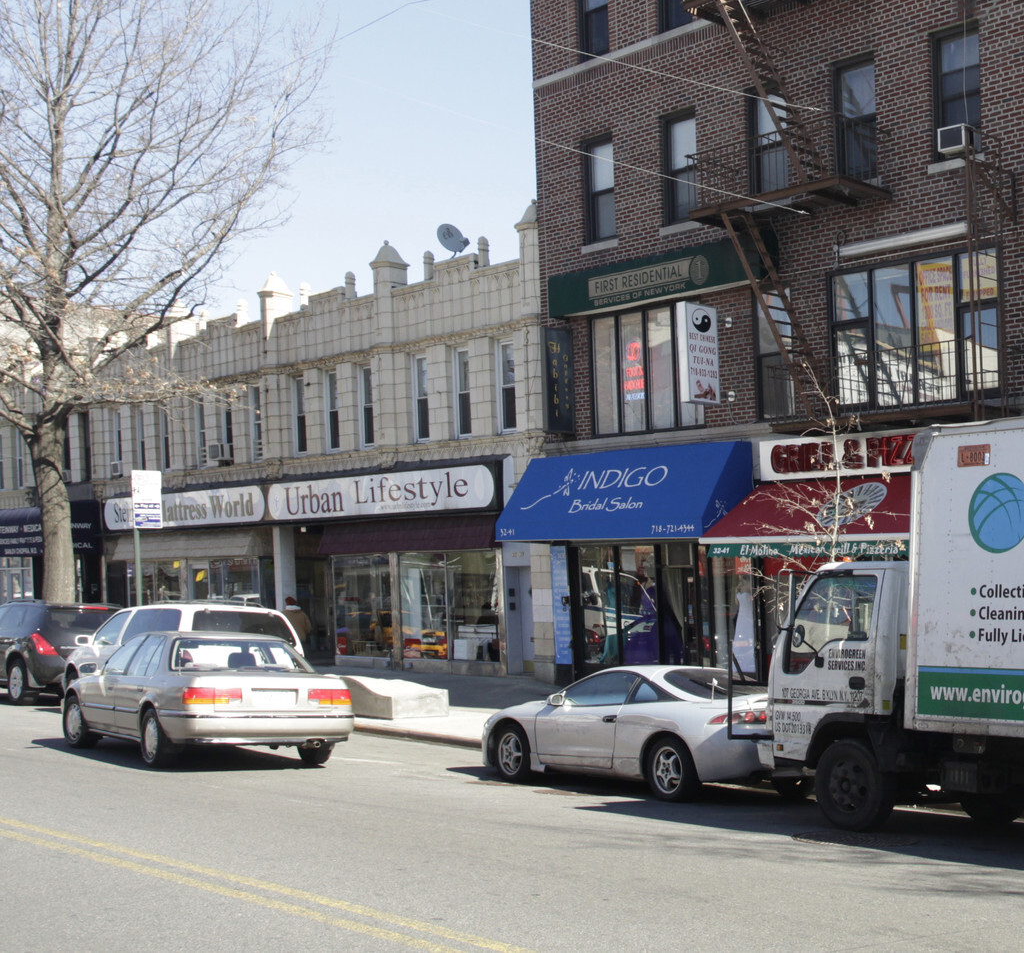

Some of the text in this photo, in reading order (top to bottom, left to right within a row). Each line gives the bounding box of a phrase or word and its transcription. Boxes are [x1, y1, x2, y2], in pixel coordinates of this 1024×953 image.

[595, 278, 618, 294] FIRST
[622, 264, 683, 289] RESIDENTIAL
[593, 281, 687, 307] SERVICES OF NEW YORK
[698, 345, 717, 356] GONG
[577, 465, 669, 491] INDIGO
[284, 471, 469, 516] Urban Lifestyle
[208, 492, 255, 519] World
[568, 496, 643, 514] Bridal Salon
[978, 628, 1008, 645] Fully
[828, 648, 866, 660] ENVIROGREEN
[790, 687, 810, 699] GEORGIA
